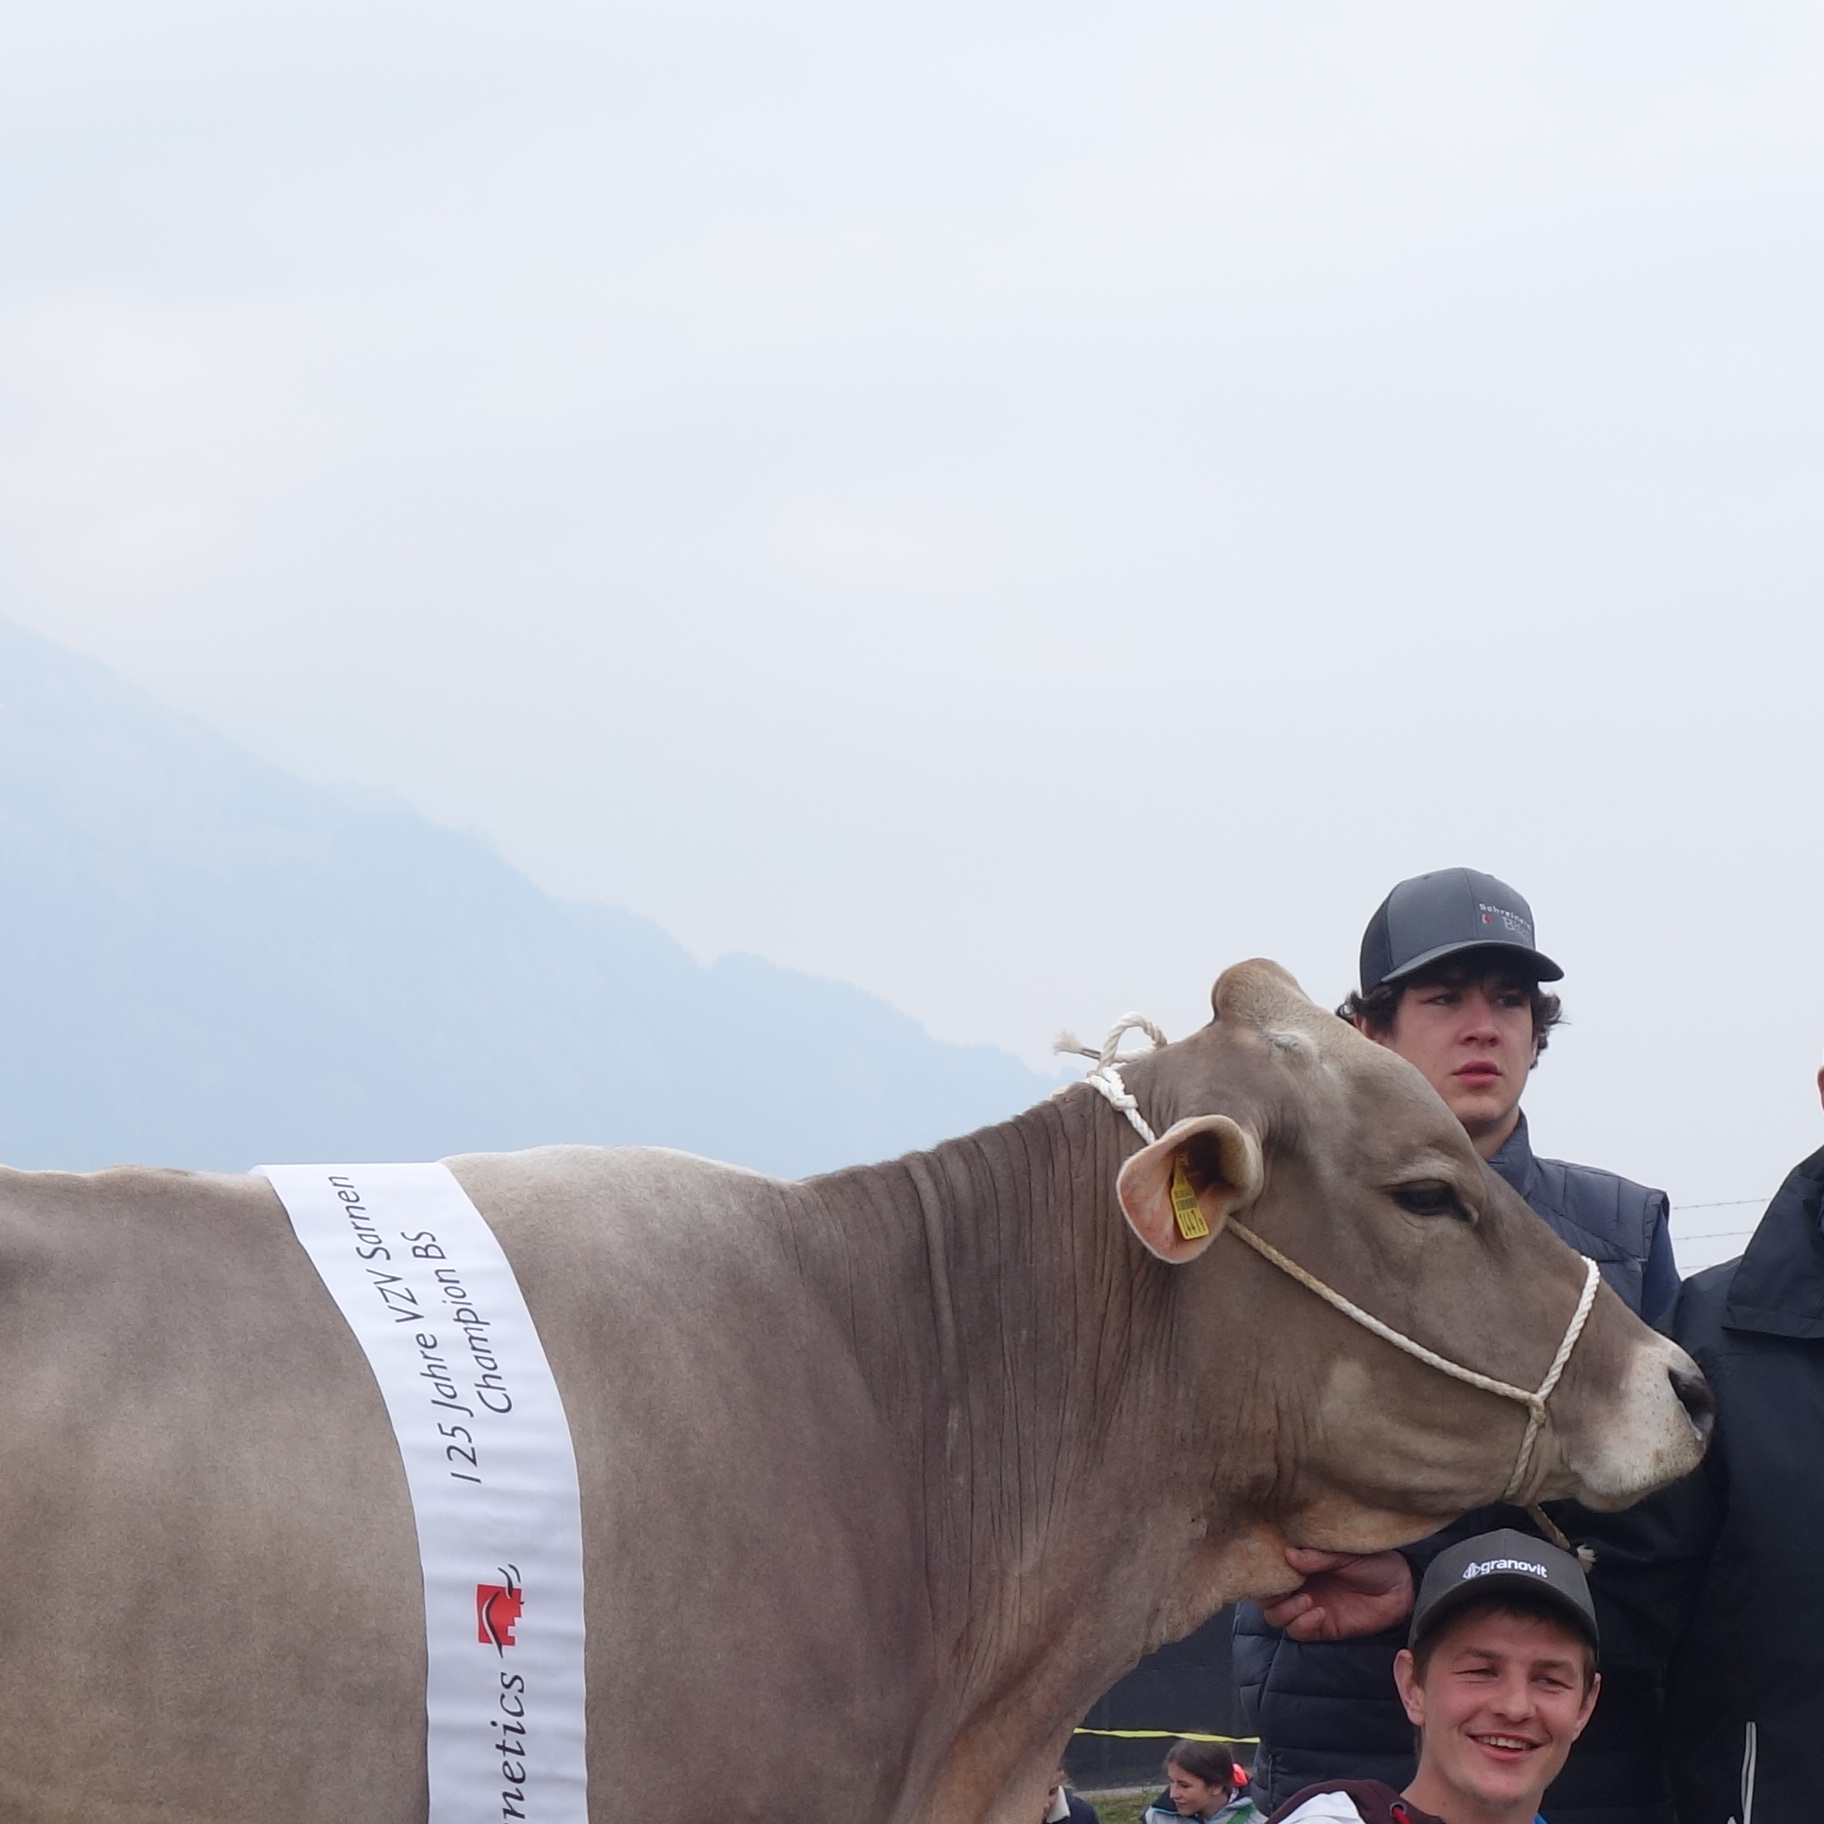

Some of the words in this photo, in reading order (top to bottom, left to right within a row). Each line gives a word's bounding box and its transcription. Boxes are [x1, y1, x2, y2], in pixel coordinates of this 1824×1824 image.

[327, 1175, 391, 1261] Sarnen
[400, 1231, 448, 1260] BS
[365, 1268, 426, 1323] VZV
[434, 1268, 513, 1414] Champion
[415, 1332, 474, 1418] Jahre
[436, 1422, 482, 1484] 125
[1480, 1559, 1548, 1578] granovit
